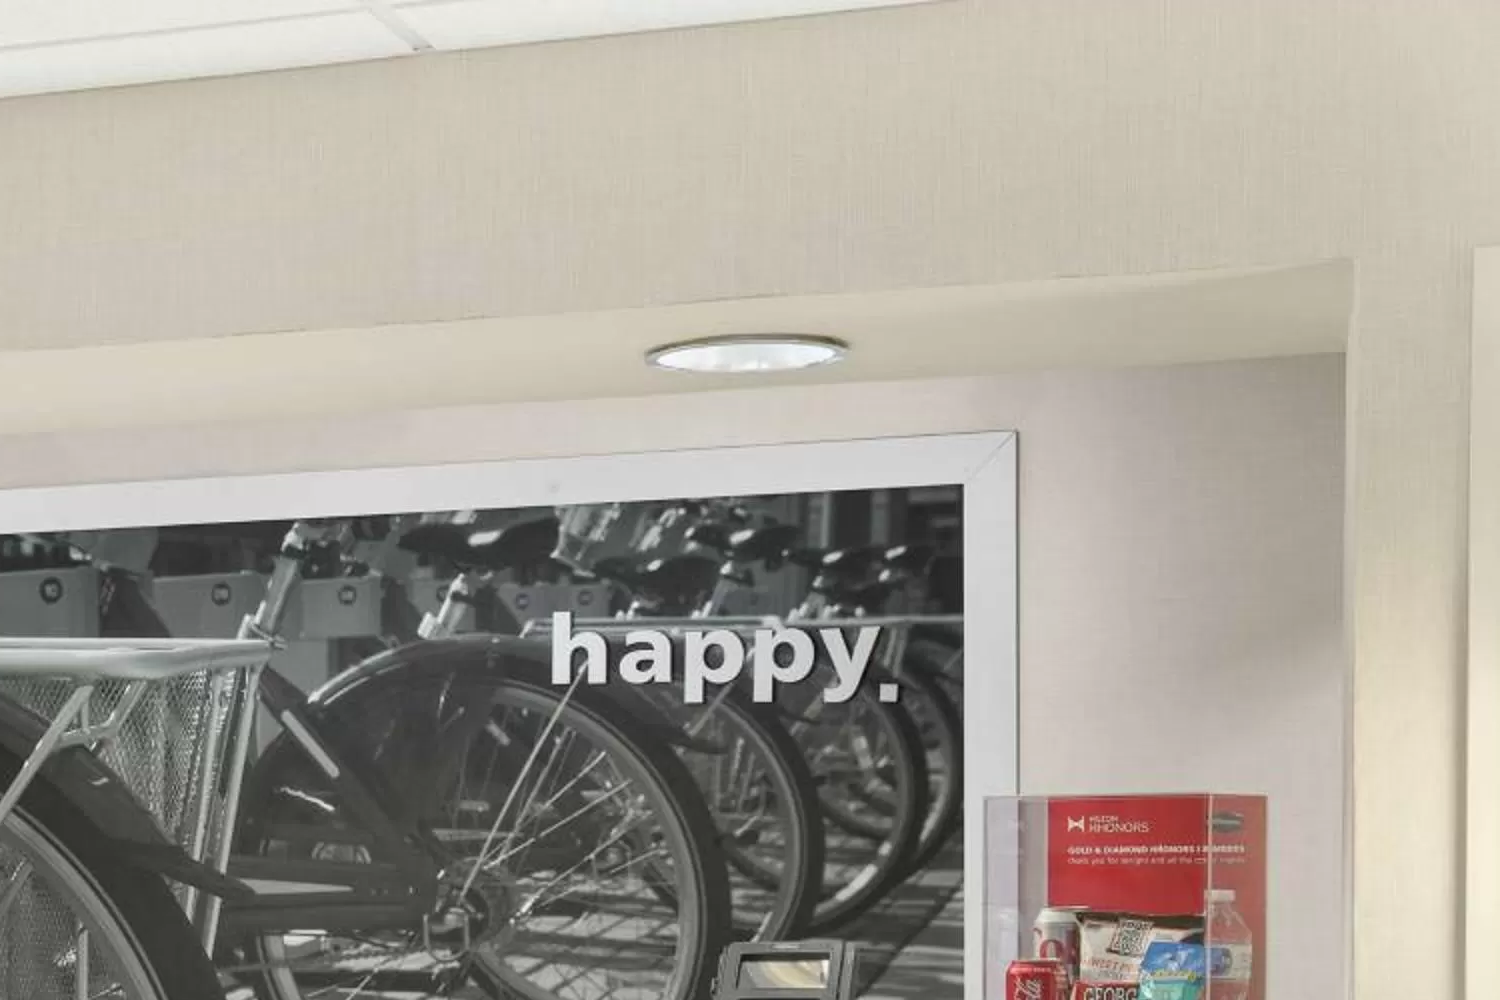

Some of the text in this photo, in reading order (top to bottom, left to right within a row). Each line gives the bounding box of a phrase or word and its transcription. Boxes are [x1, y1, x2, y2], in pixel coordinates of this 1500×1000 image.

[551, 611, 899, 703] happy.
[1067, 845, 1092, 855] GOLD
[1104, 845, 1149, 855] DIAMOND
